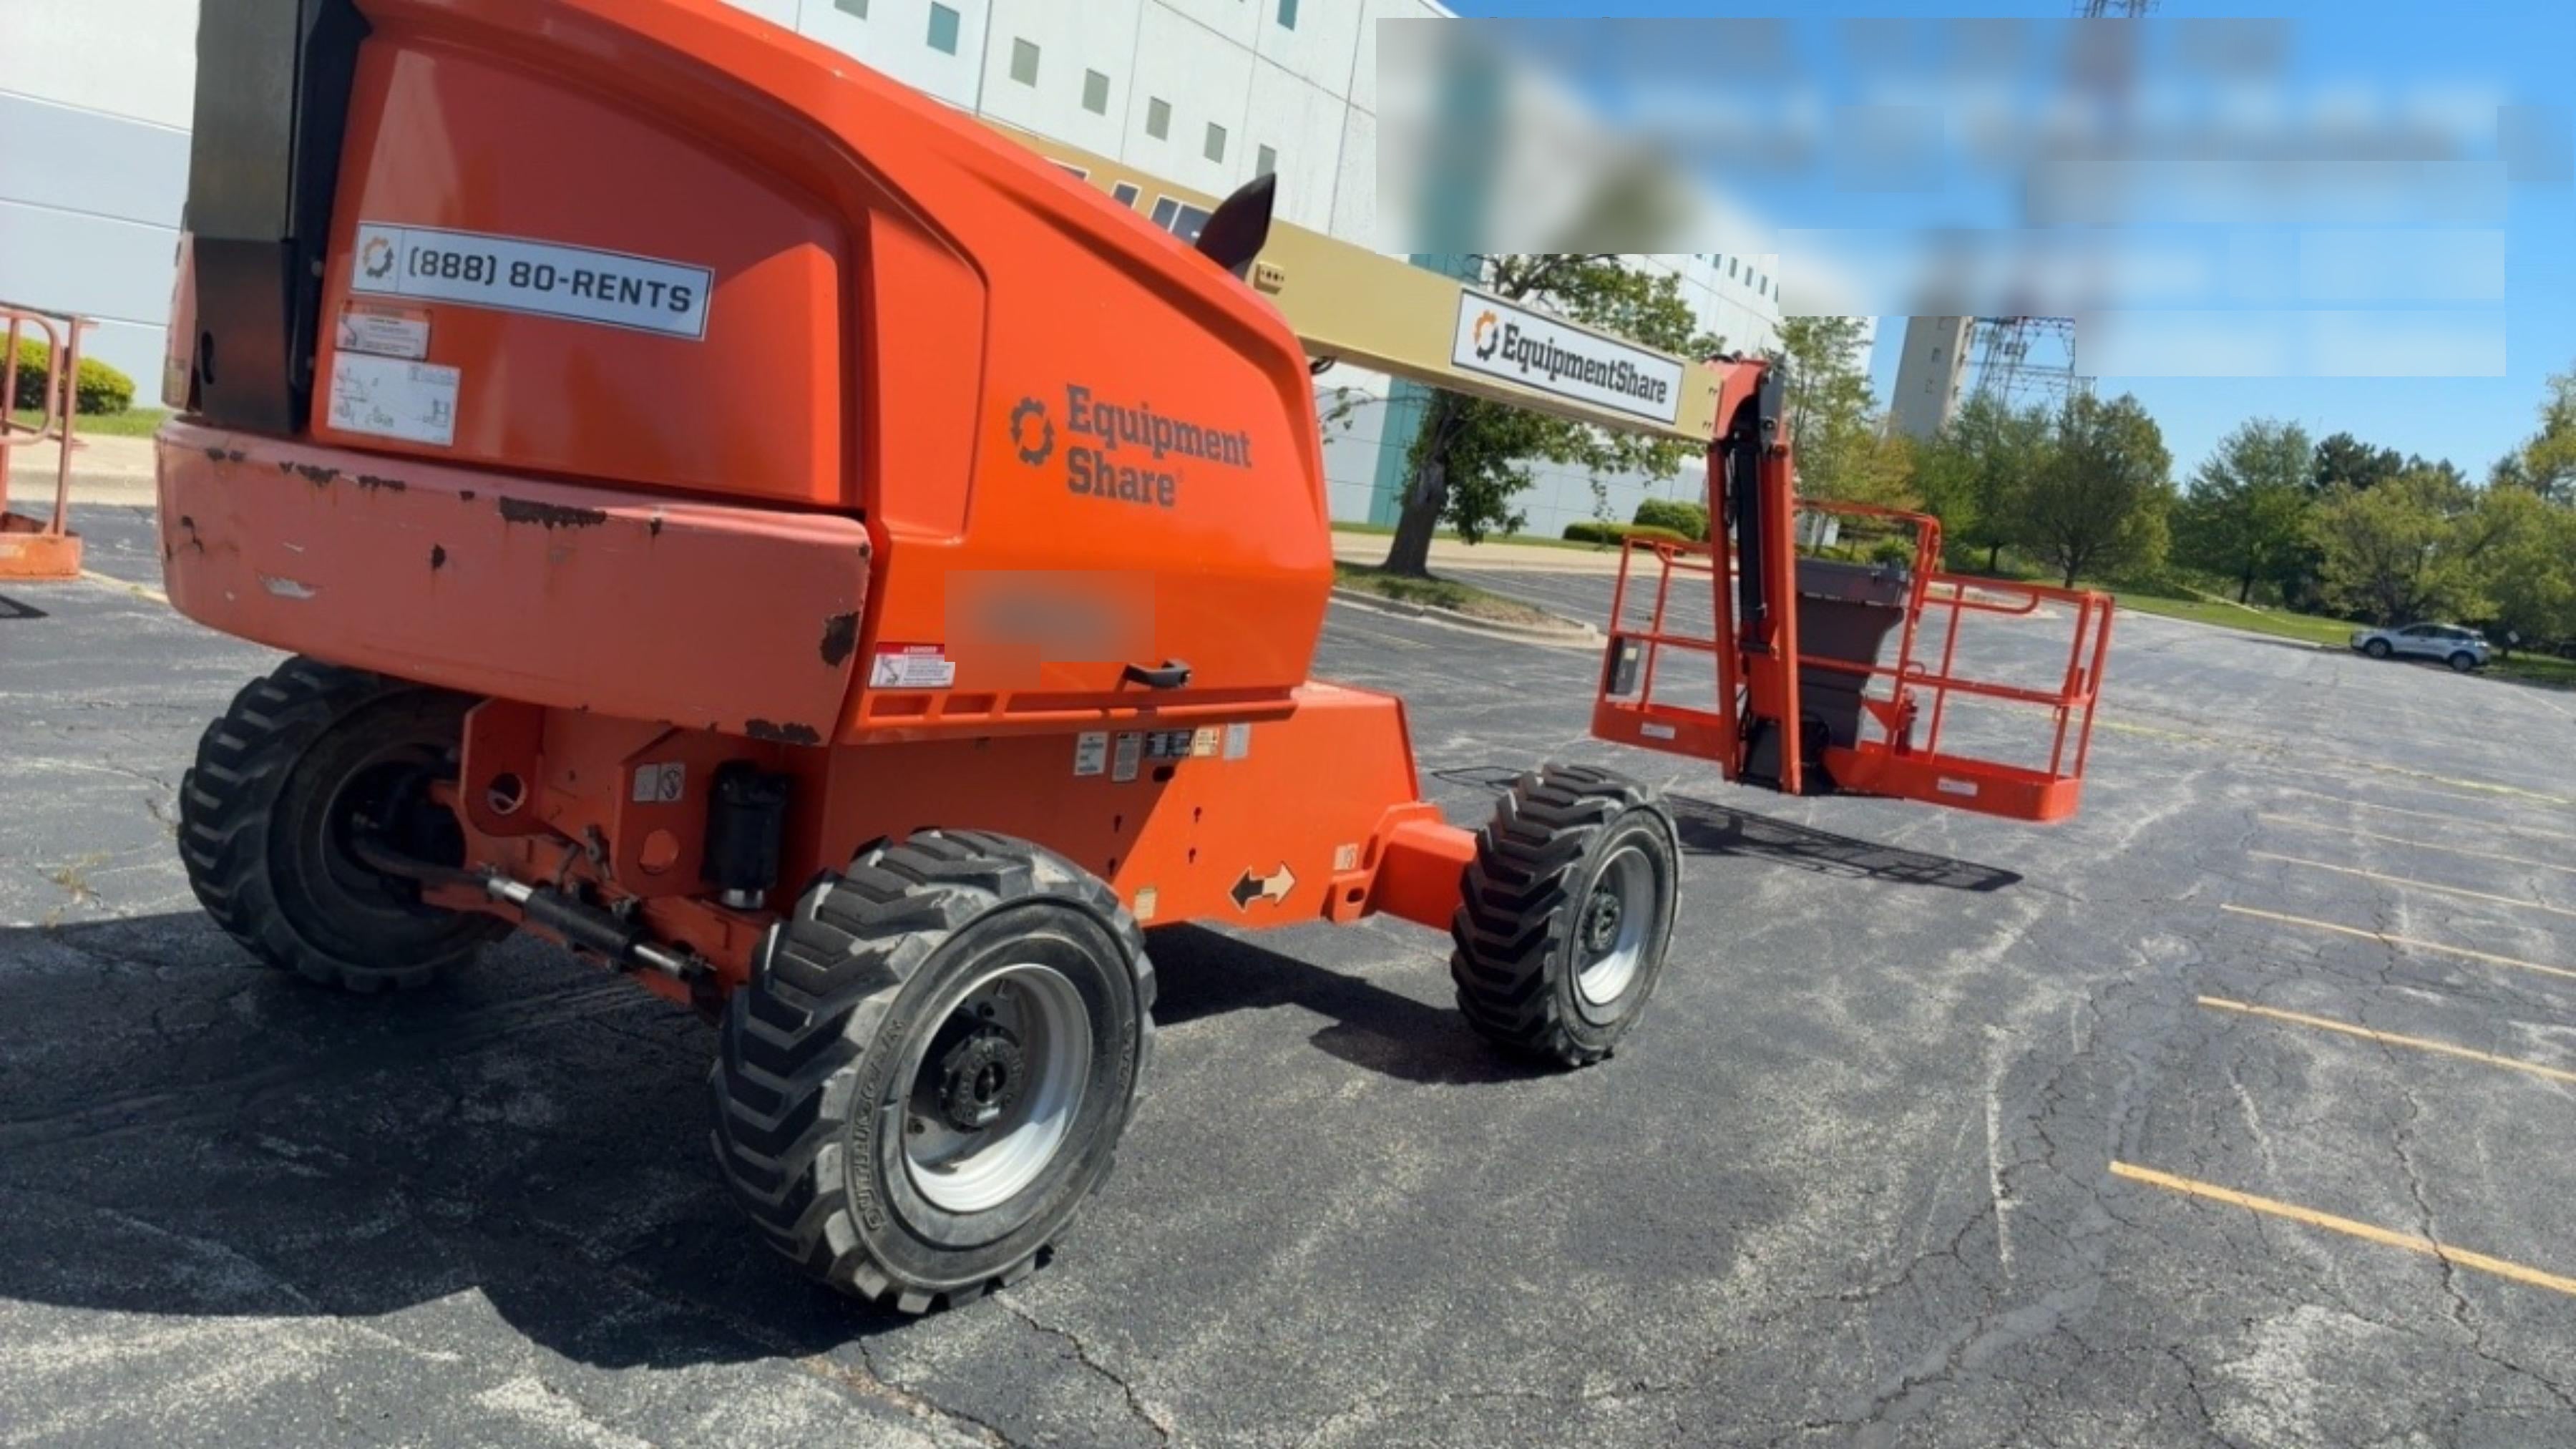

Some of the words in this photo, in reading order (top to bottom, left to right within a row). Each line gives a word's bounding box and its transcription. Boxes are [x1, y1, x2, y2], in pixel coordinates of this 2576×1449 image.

[409, 246, 497, 285] (888)
[508, 260, 692, 313] 80-RENTS
[1501, 323, 1667, 403] EquipmentShare
[1067, 384, 1252, 468] Equipment
[1068, 446, 1175, 507] Share
